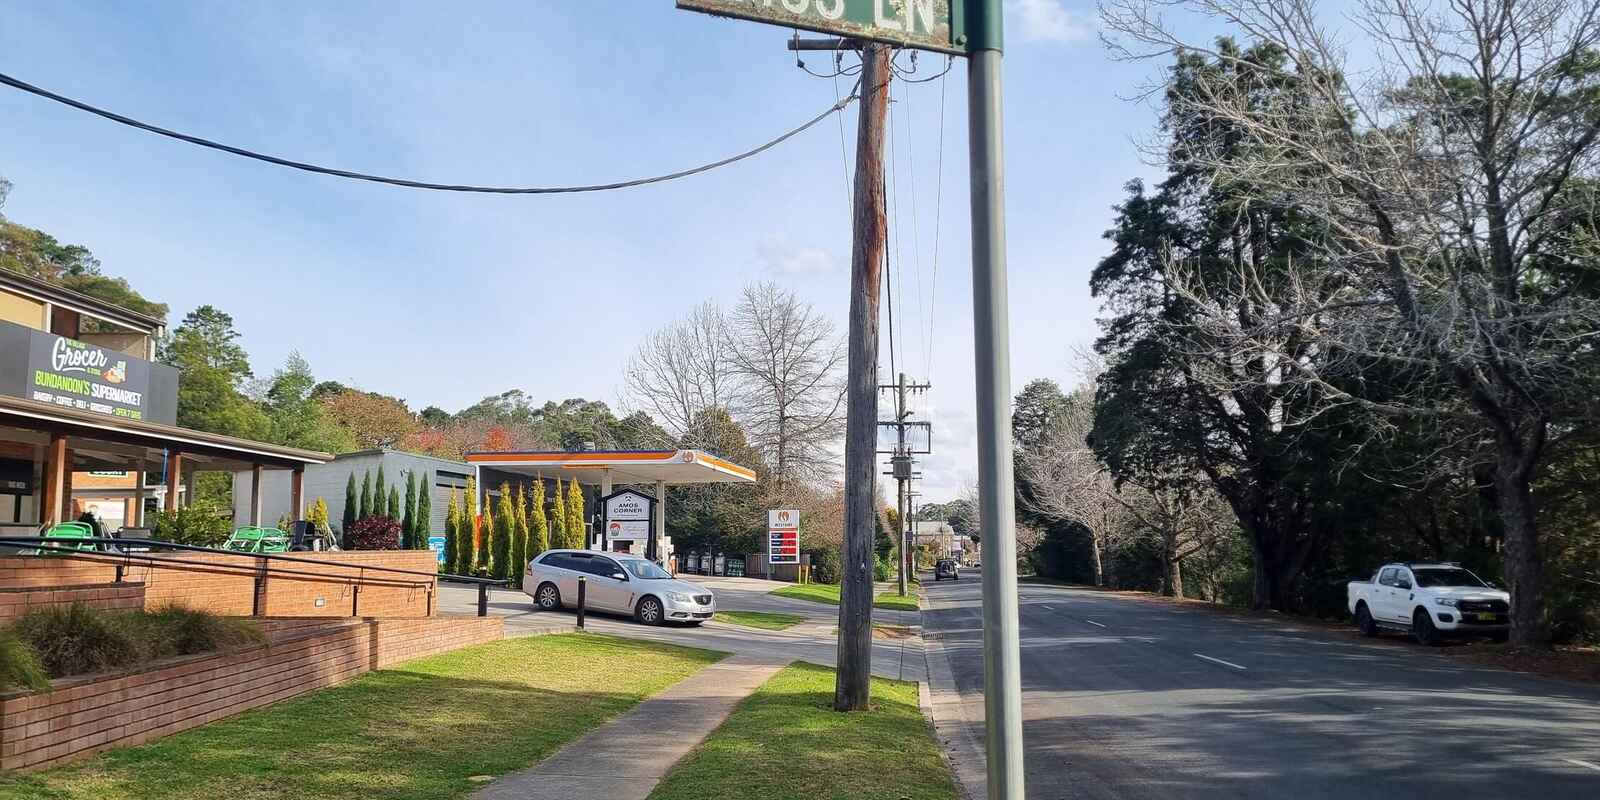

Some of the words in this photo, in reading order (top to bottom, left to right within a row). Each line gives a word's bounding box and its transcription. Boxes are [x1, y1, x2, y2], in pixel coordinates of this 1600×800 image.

[874, 0, 934, 34] LN
[52, 337, 107, 371] Grocer
[91, 383, 142, 406] SUPERMARKET
